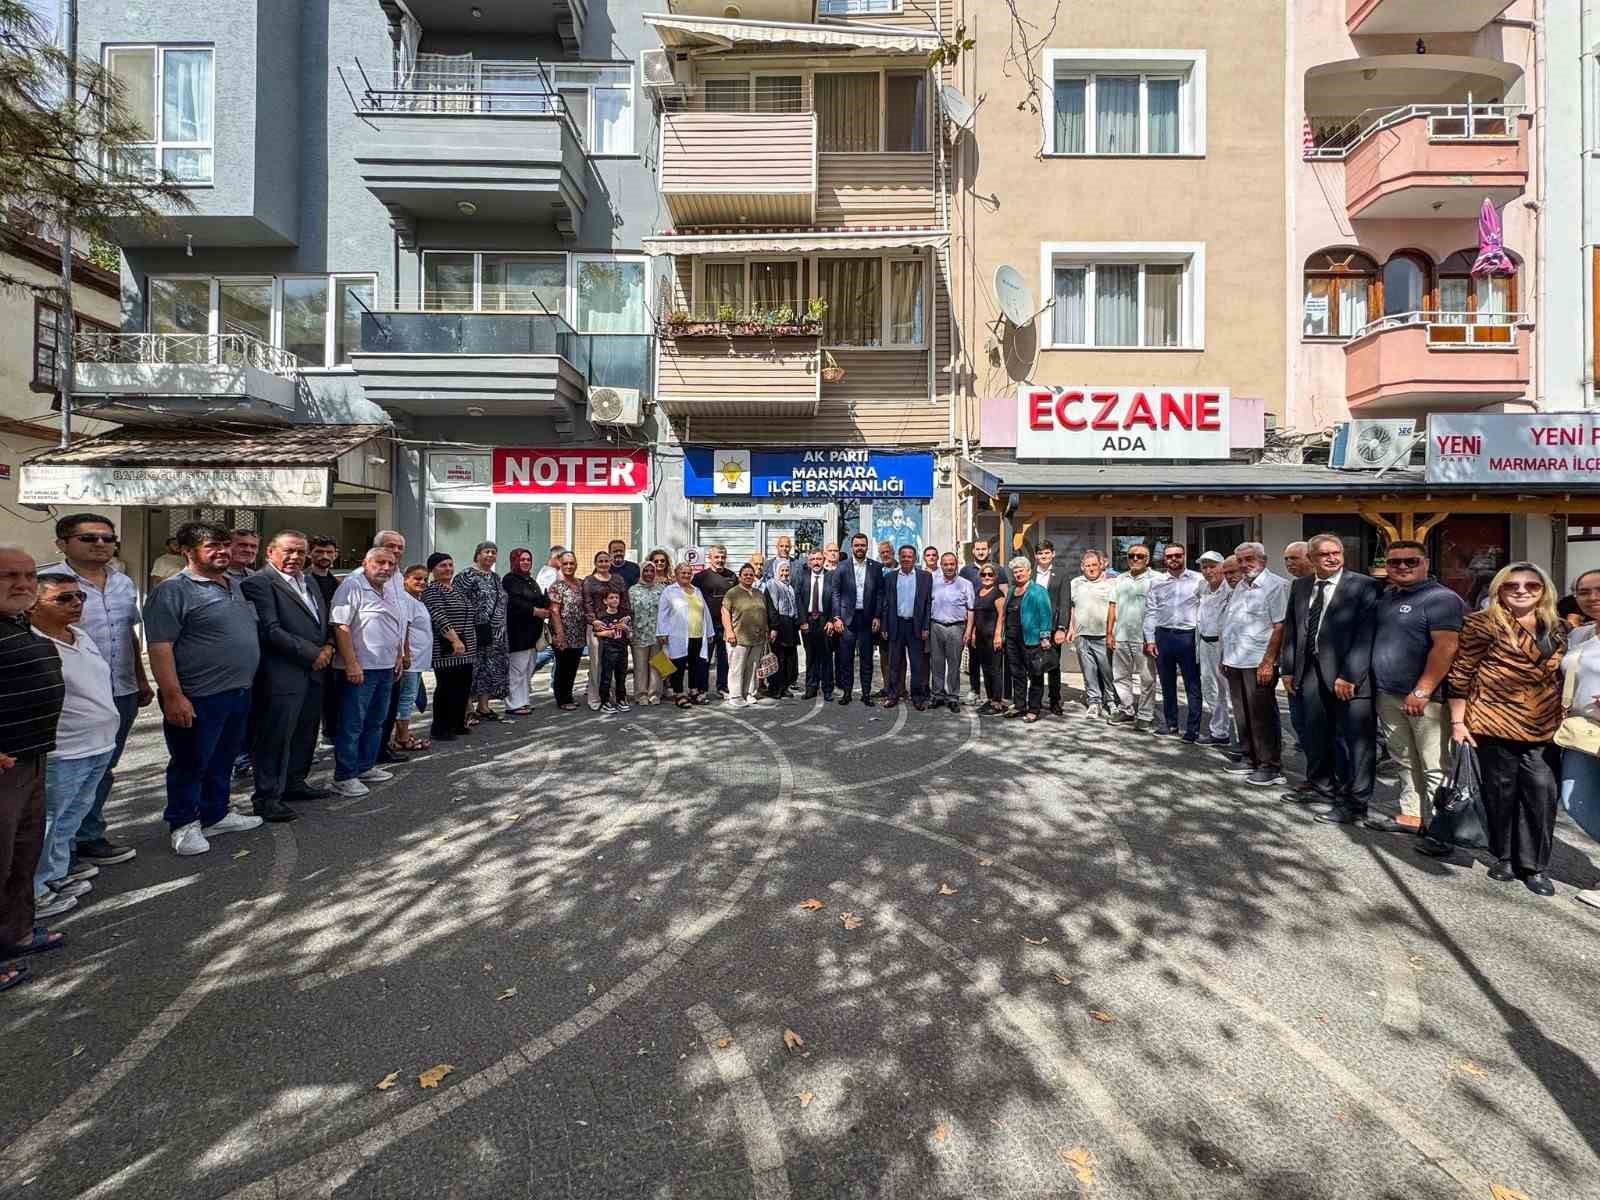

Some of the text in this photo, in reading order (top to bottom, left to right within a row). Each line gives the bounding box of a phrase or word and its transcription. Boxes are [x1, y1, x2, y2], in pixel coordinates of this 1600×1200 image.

[1029, 391, 1221, 431] ECZANE
[1530, 424, 1584, 446] YENİ
[1102, 436, 1147, 451] ADA
[803, 448, 869, 463] AK PARTİ
[506, 456, 635, 486] NOTER
[1490, 457, 1569, 471] MARMARA
[792, 466, 878, 479] MARMARA
[806, 477, 904, 495] BAŞKANLIĞI
